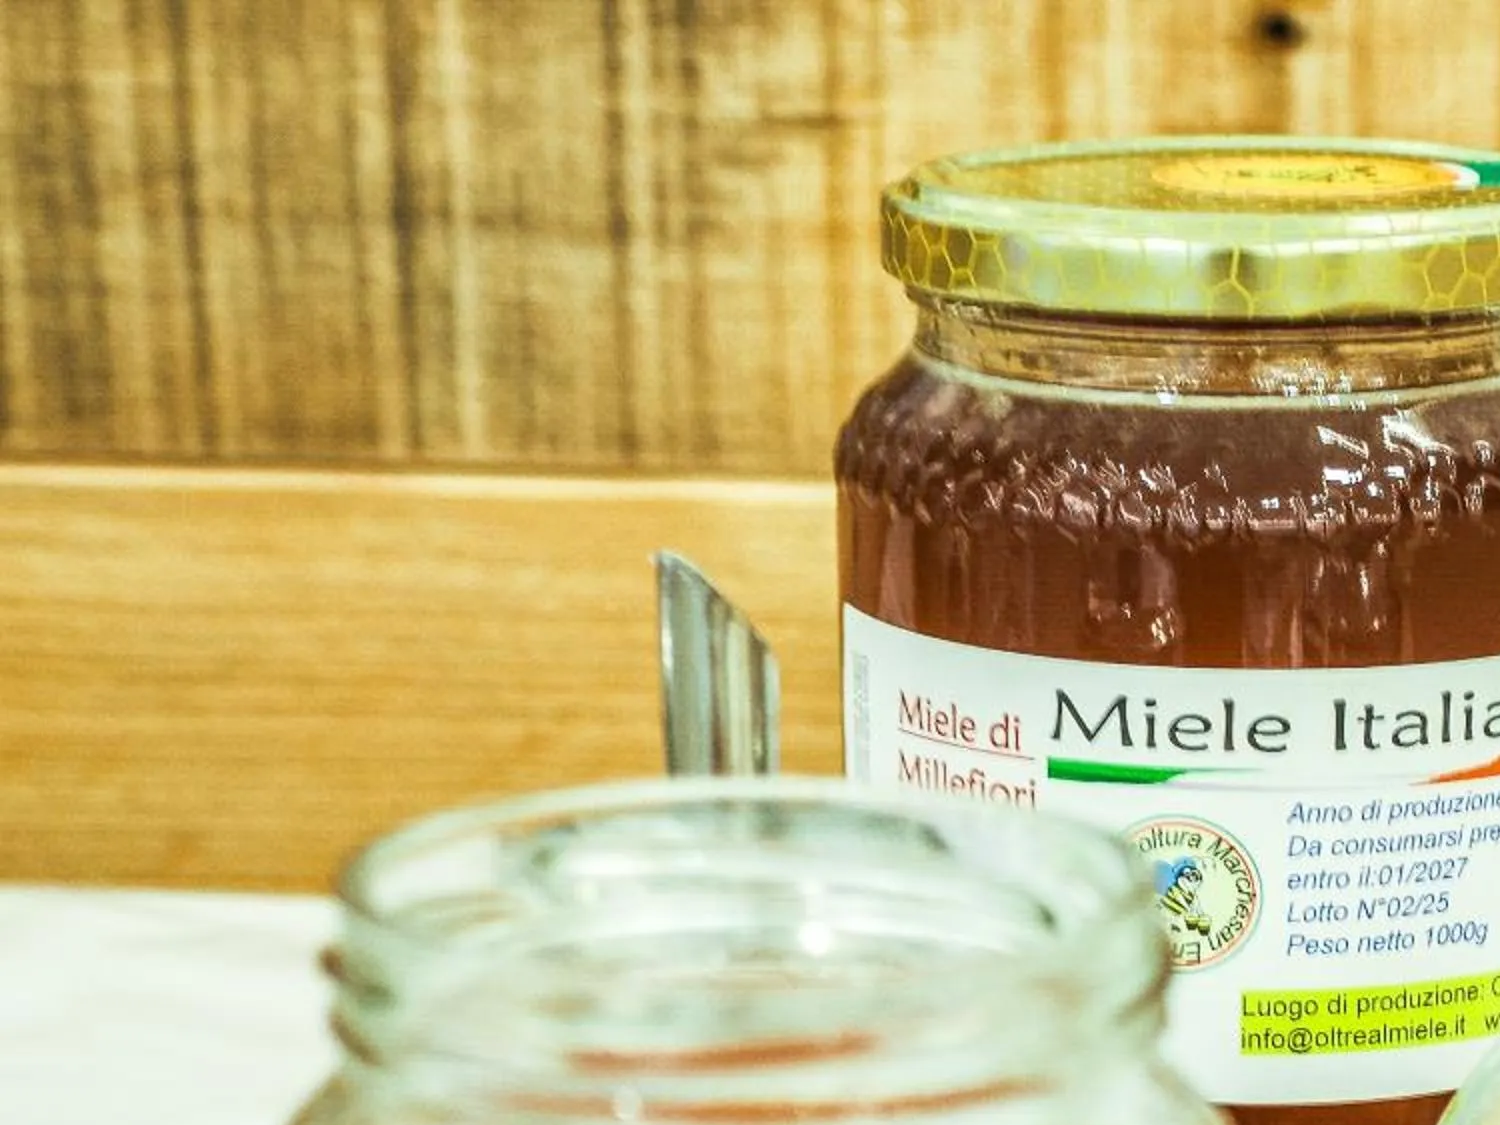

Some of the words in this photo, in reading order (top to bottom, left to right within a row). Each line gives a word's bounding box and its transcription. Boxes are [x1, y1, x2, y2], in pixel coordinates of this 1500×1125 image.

[898, 687, 976, 743] Miele
[989, 712, 1021, 752] di
[1051, 687, 1292, 753] Miele
[1287, 801, 1353, 824] Anno
[1361, 799, 1383, 822] di
[1287, 834, 1323, 857] Da
[1330, 824, 1464, 856] consumarsi
[1139, 827, 1203, 853] oltura
[1206, 837, 1254, 951] Marchesan
[1287, 870, 1351, 890] entro
[1287, 902, 1349, 923] Lotto
[1356, 891, 1450, 921] N°02/25
[1287, 933, 1349, 956] Peso
[1357, 929, 1415, 953] netto
[1425, 920, 1489, 948] 1000g
[1241, 994, 1319, 1022] Luogo
[1327, 994, 1348, 1016] di
[1356, 981, 1485, 1019] produzione:
[1240, 1017, 1467, 1054] info@oltrealmiele.it
